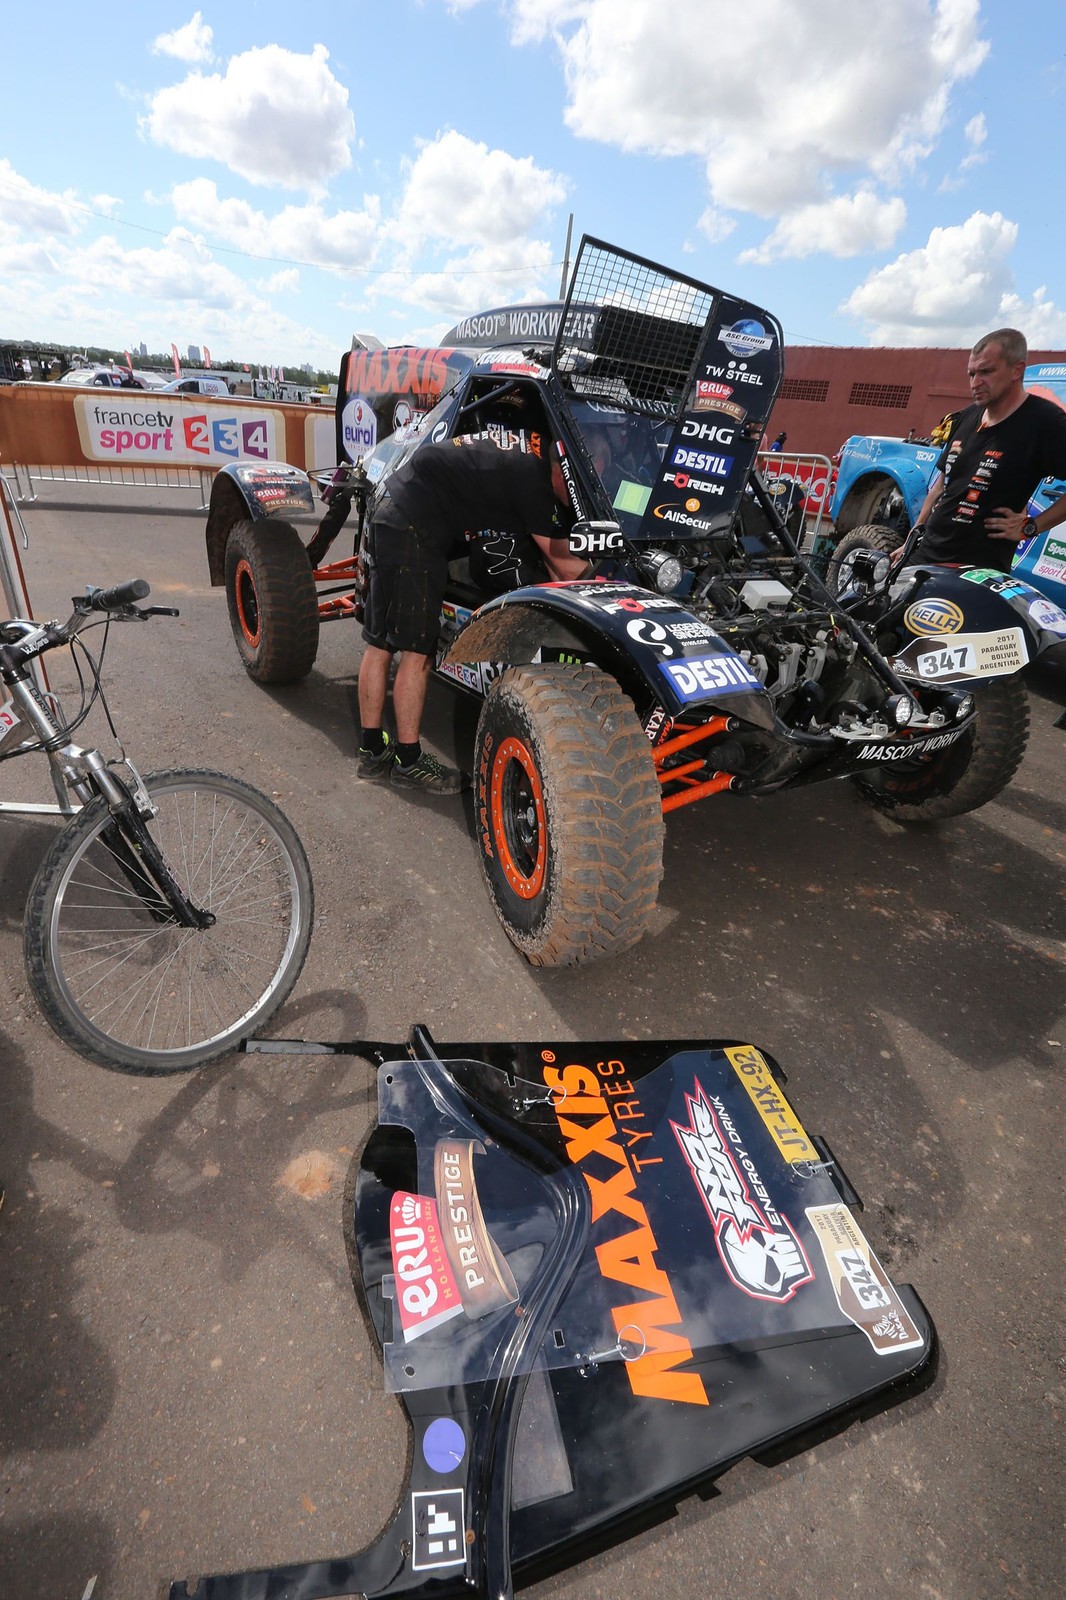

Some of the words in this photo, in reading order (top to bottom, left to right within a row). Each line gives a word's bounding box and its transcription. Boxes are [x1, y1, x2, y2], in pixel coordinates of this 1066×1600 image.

[509, 311, 595, 339] WORKWEAR
[345, 348, 455, 394] MAXXIS
[705, 364, 725, 378] TW
[725, 369, 764, 386] STEEL
[94, 406, 174, 428] francetv
[698, 398, 741, 415] PRESTIGE
[99, 429, 173, 453] sport
[246, 425, 268, 454] 4
[344, 424, 374, 446] eurol
[681, 420, 735, 445] DHG
[673, 448, 728, 475] DESTIL
[560, 458, 571, 480] Tim
[567, 480, 586, 521] Coronel
[663, 509, 712, 530] AllSecur
[569, 532, 624, 552] DHG
[911, 606, 961, 632] HELLA
[981, 643, 1017, 654] PARAGUAY
[996, 635, 1015, 643] 2017
[923, 647, 969, 675] 347
[979, 659, 1021, 671] ARGENTINA
[990, 651, 1019, 660] BOLIVIA
[667, 656, 759, 695] DESTIL
[479, 731, 494, 858] MAXXIS
[733, 1050, 809, 1152] JT-HX-92
[597, 1059, 663, 1174] TYRES
[708, 1095, 743, 1144] DRINK
[735, 1146, 783, 1227] ENERGY
[443, 1151, 486, 1291] PRESTIGE
[814, 1213, 827, 1231] 2017
[822, 1213, 844, 1245] PARAGUAY
[837, 1211, 861, 1247] ARGENTINA
[427, 1225, 453, 1299] HOLLAND
[840, 1255, 888, 1308] 347
[888, 1308, 909, 1341] DAKAR
